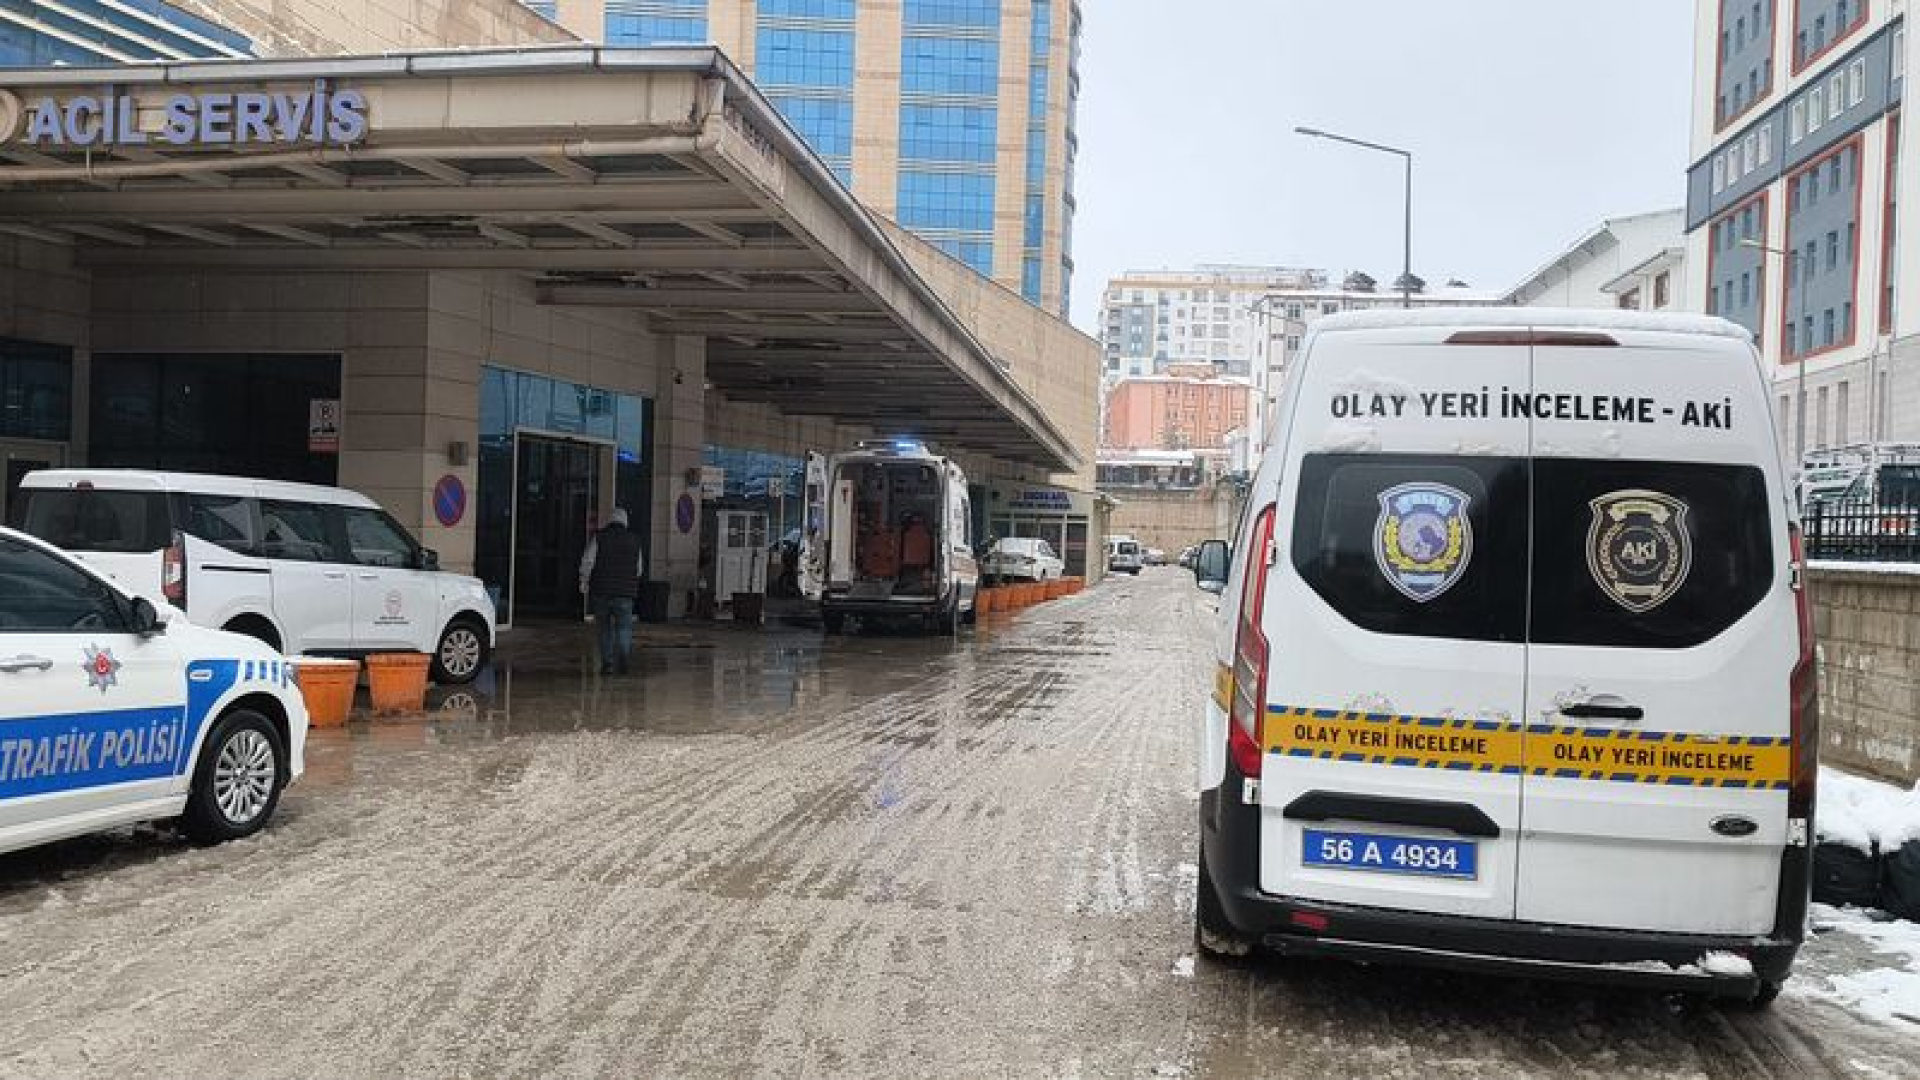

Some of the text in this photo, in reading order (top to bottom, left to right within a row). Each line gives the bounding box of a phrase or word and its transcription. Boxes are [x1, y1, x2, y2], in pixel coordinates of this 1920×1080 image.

[29, 78, 369, 145] ACİL SERVİS
[1331, 393, 1406, 418] OLAY
[1420, 386, 1489, 418] YERİ
[1502, 386, 1654, 423] İNCELEME
[1681, 397, 1731, 430] AKİ
[1621, 540, 1657, 560] AKİ
[0, 718, 178, 781] TRAFİK POLİSİ
[1294, 724, 1488, 755] OLAY YERİ İNCELEME
[1554, 743, 1756, 772] OLAY YERİ İNCELEME
[1321, 838, 1460, 871] 56 A 4934
